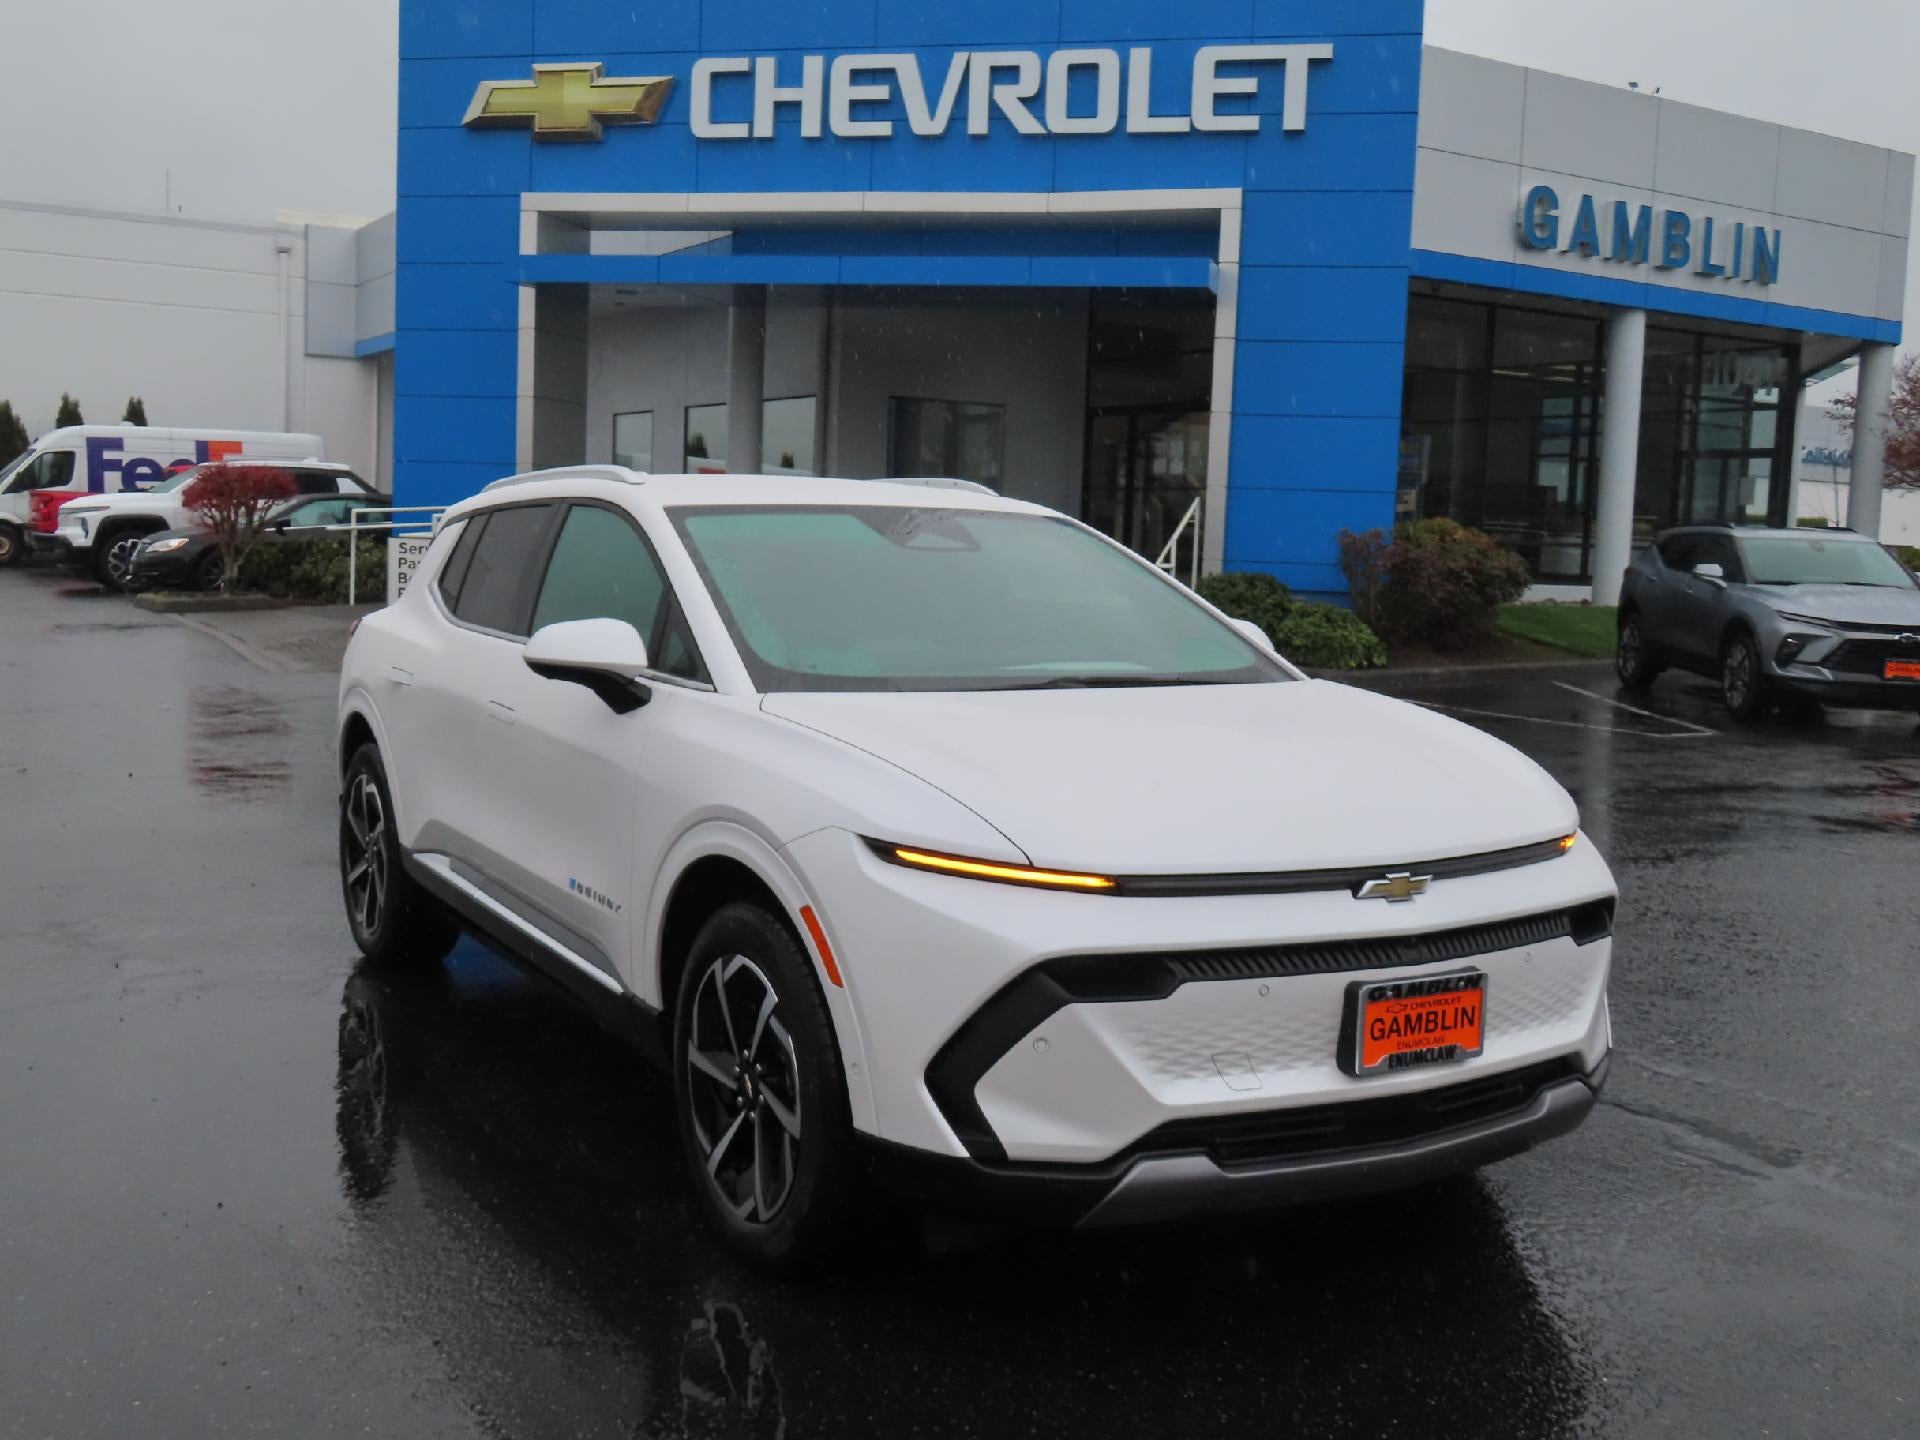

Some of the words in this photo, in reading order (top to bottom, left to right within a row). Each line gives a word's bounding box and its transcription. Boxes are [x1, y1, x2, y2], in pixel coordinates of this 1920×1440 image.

[691, 43, 1333, 138] CHEVROLET
[1522, 185, 1781, 285] GAMBLIN
[1410, 996, 1462, 1010] CHEVROLET
[1370, 1005, 1476, 1042] GAMBLIN
[1388, 1045, 1458, 1069] ENUMCLAW
[1397, 1036, 1446, 1050] ENUMCLAW
